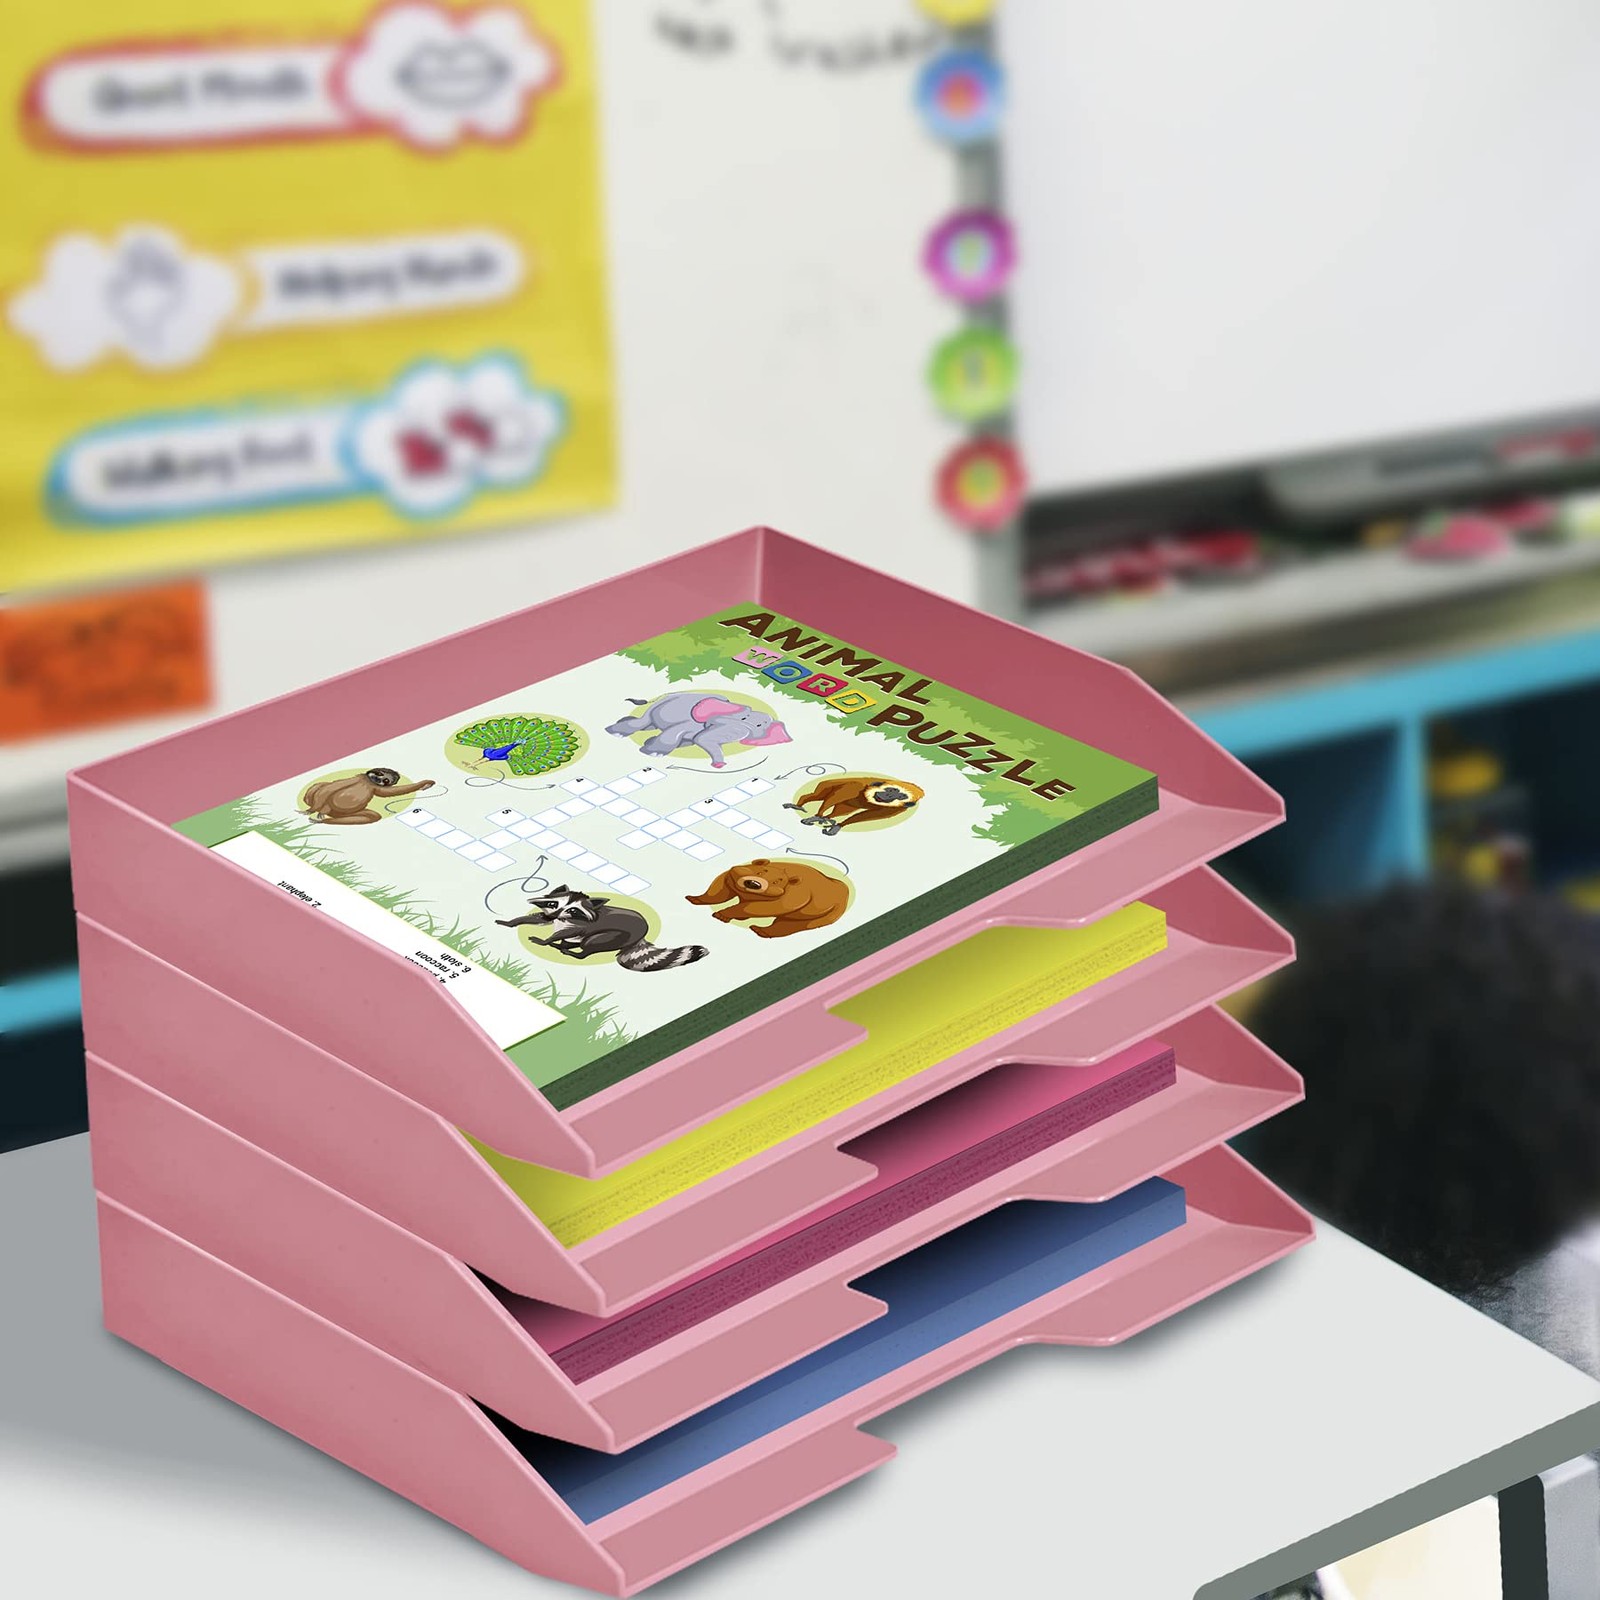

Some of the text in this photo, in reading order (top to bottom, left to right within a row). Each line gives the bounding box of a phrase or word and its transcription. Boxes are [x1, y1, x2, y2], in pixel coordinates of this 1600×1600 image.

[718, 611, 931, 706] ANIMAL
[738, 647, 873, 712] WORD
[865, 703, 1077, 803] PUZZLE
[276, 880, 313, 902] elephant
[415, 950, 451, 973] raccoon
[440, 952, 463, 967] sloth
[461, 965, 472, 974] 6.
[448, 970, 460, 979] 5.
